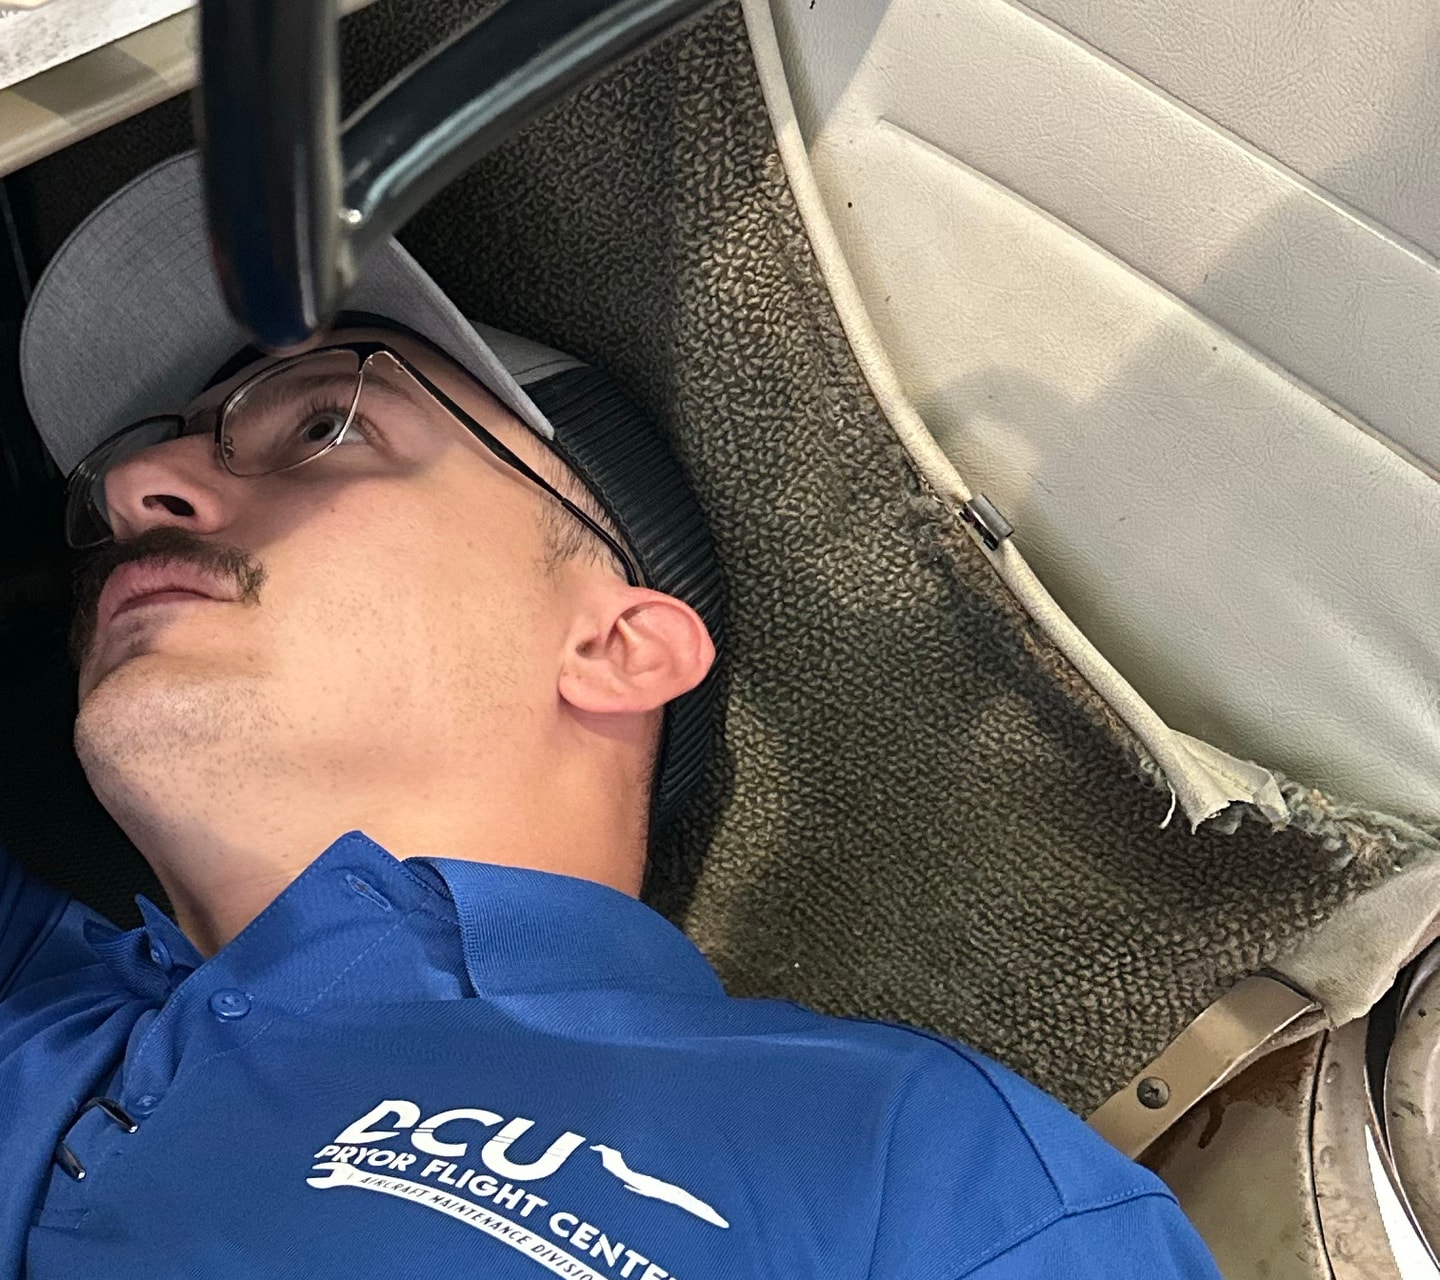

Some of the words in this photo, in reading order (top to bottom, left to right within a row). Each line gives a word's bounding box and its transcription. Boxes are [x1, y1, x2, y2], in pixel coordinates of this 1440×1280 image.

[333, 1099, 587, 1182] DCU
[314, 1144, 417, 1173] PRYOR
[420, 1159, 549, 1219] FLIGHT
[359, 1175, 430, 1199] AIRCRAFT
[428, 1194, 533, 1246] MAINTENANCE
